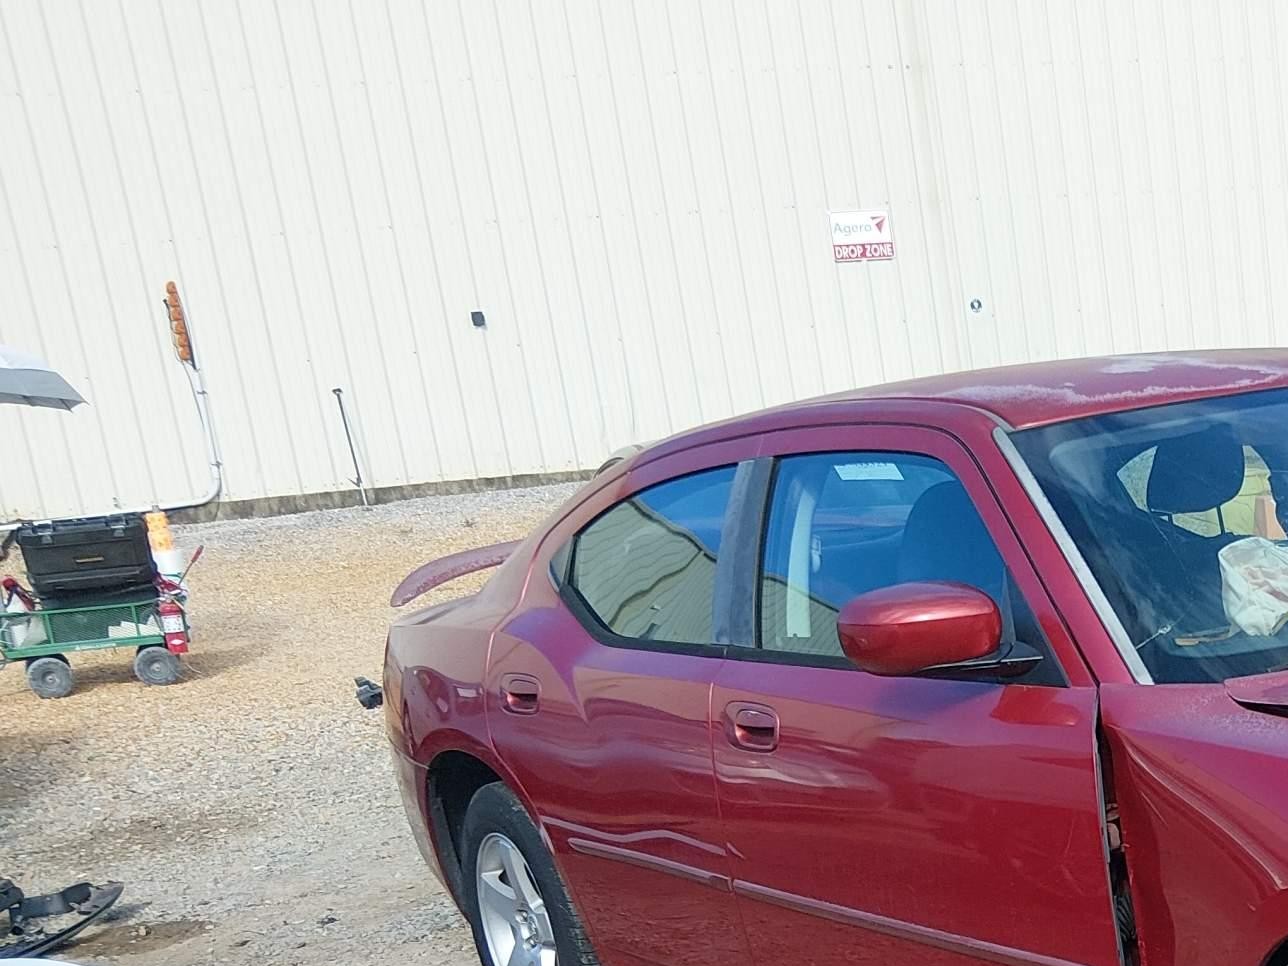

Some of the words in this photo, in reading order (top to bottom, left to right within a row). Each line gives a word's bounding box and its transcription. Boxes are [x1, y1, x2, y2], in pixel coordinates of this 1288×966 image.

[833, 222, 872, 237] Agero
[835, 244, 864, 260] DROP
[865, 243, 893, 258] ZONE
